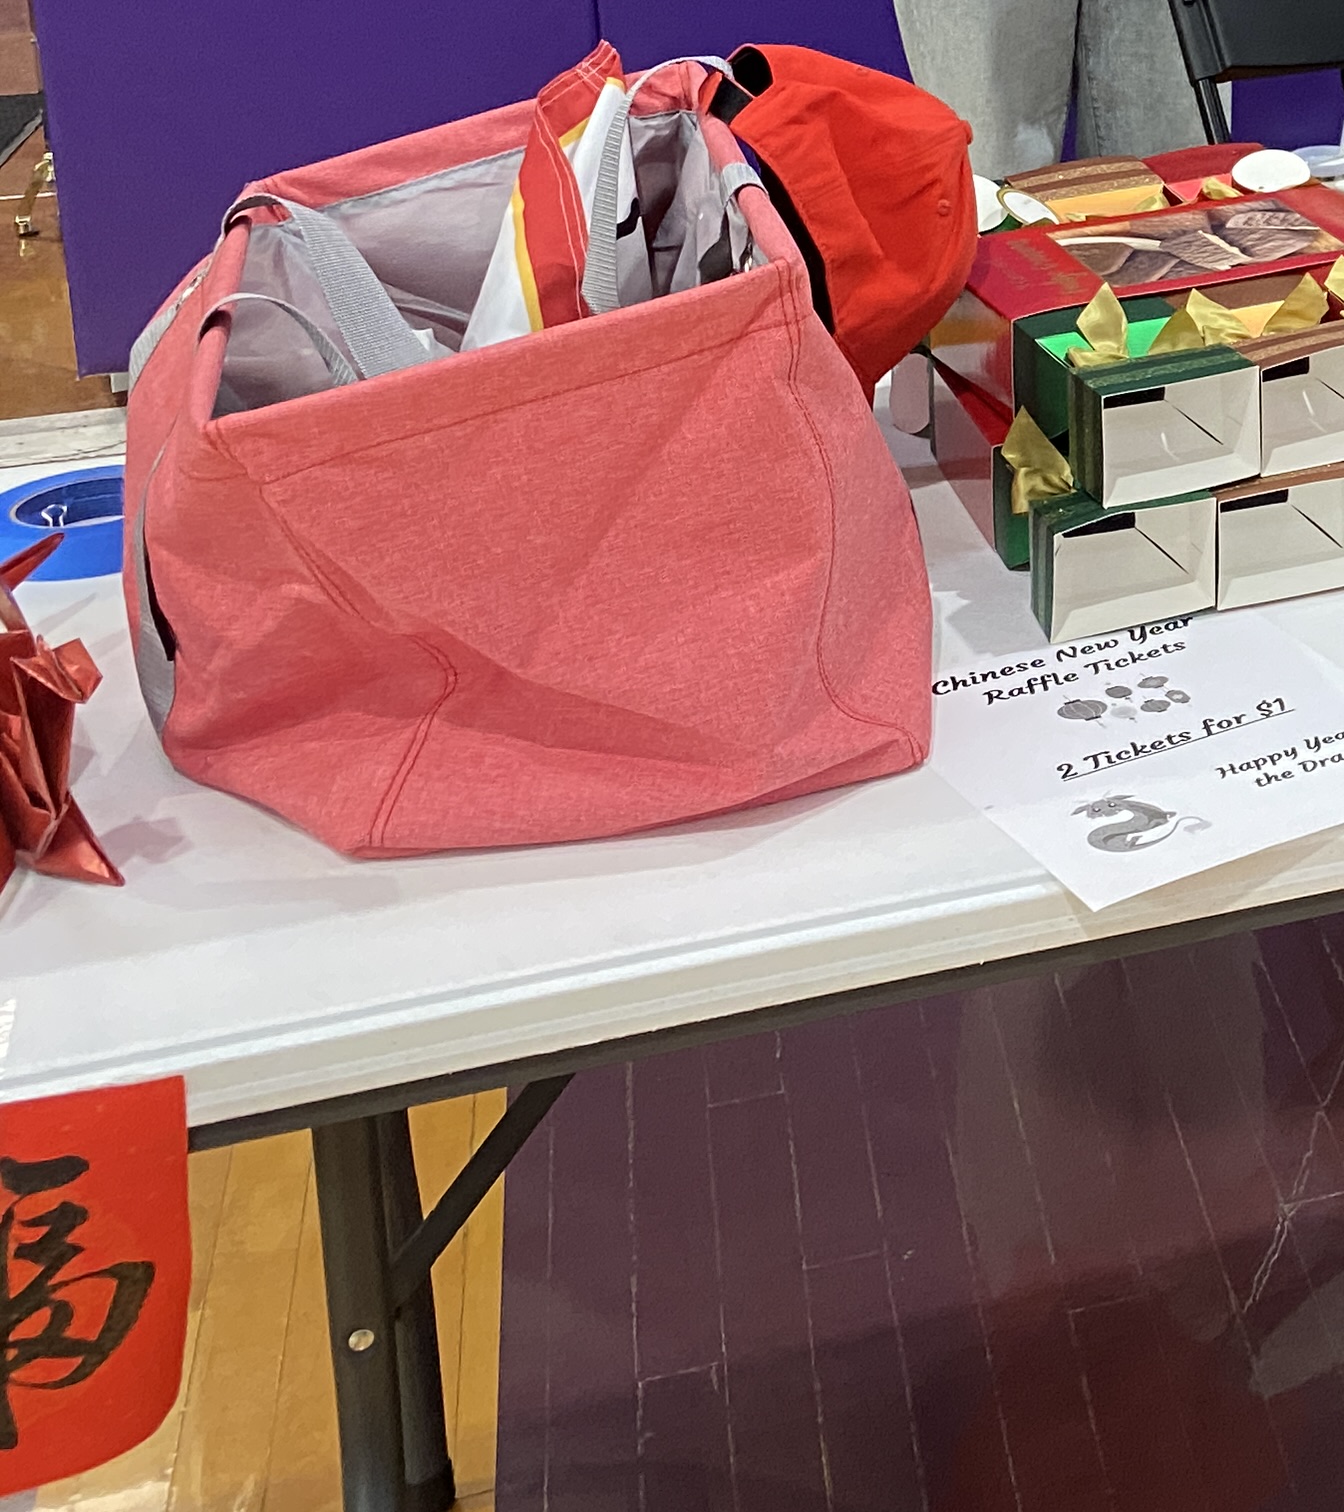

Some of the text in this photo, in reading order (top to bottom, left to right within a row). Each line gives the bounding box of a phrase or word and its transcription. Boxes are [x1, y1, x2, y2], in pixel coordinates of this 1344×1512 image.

[931, 615, 1194, 698] Chinese New Year
[982, 638, 1187, 707] Raffle Tickets
[1056, 696, 1287, 782] 2 Tickets for $1
[1216, 743, 1298, 781] Happy
[1254, 766, 1295, 789] the
